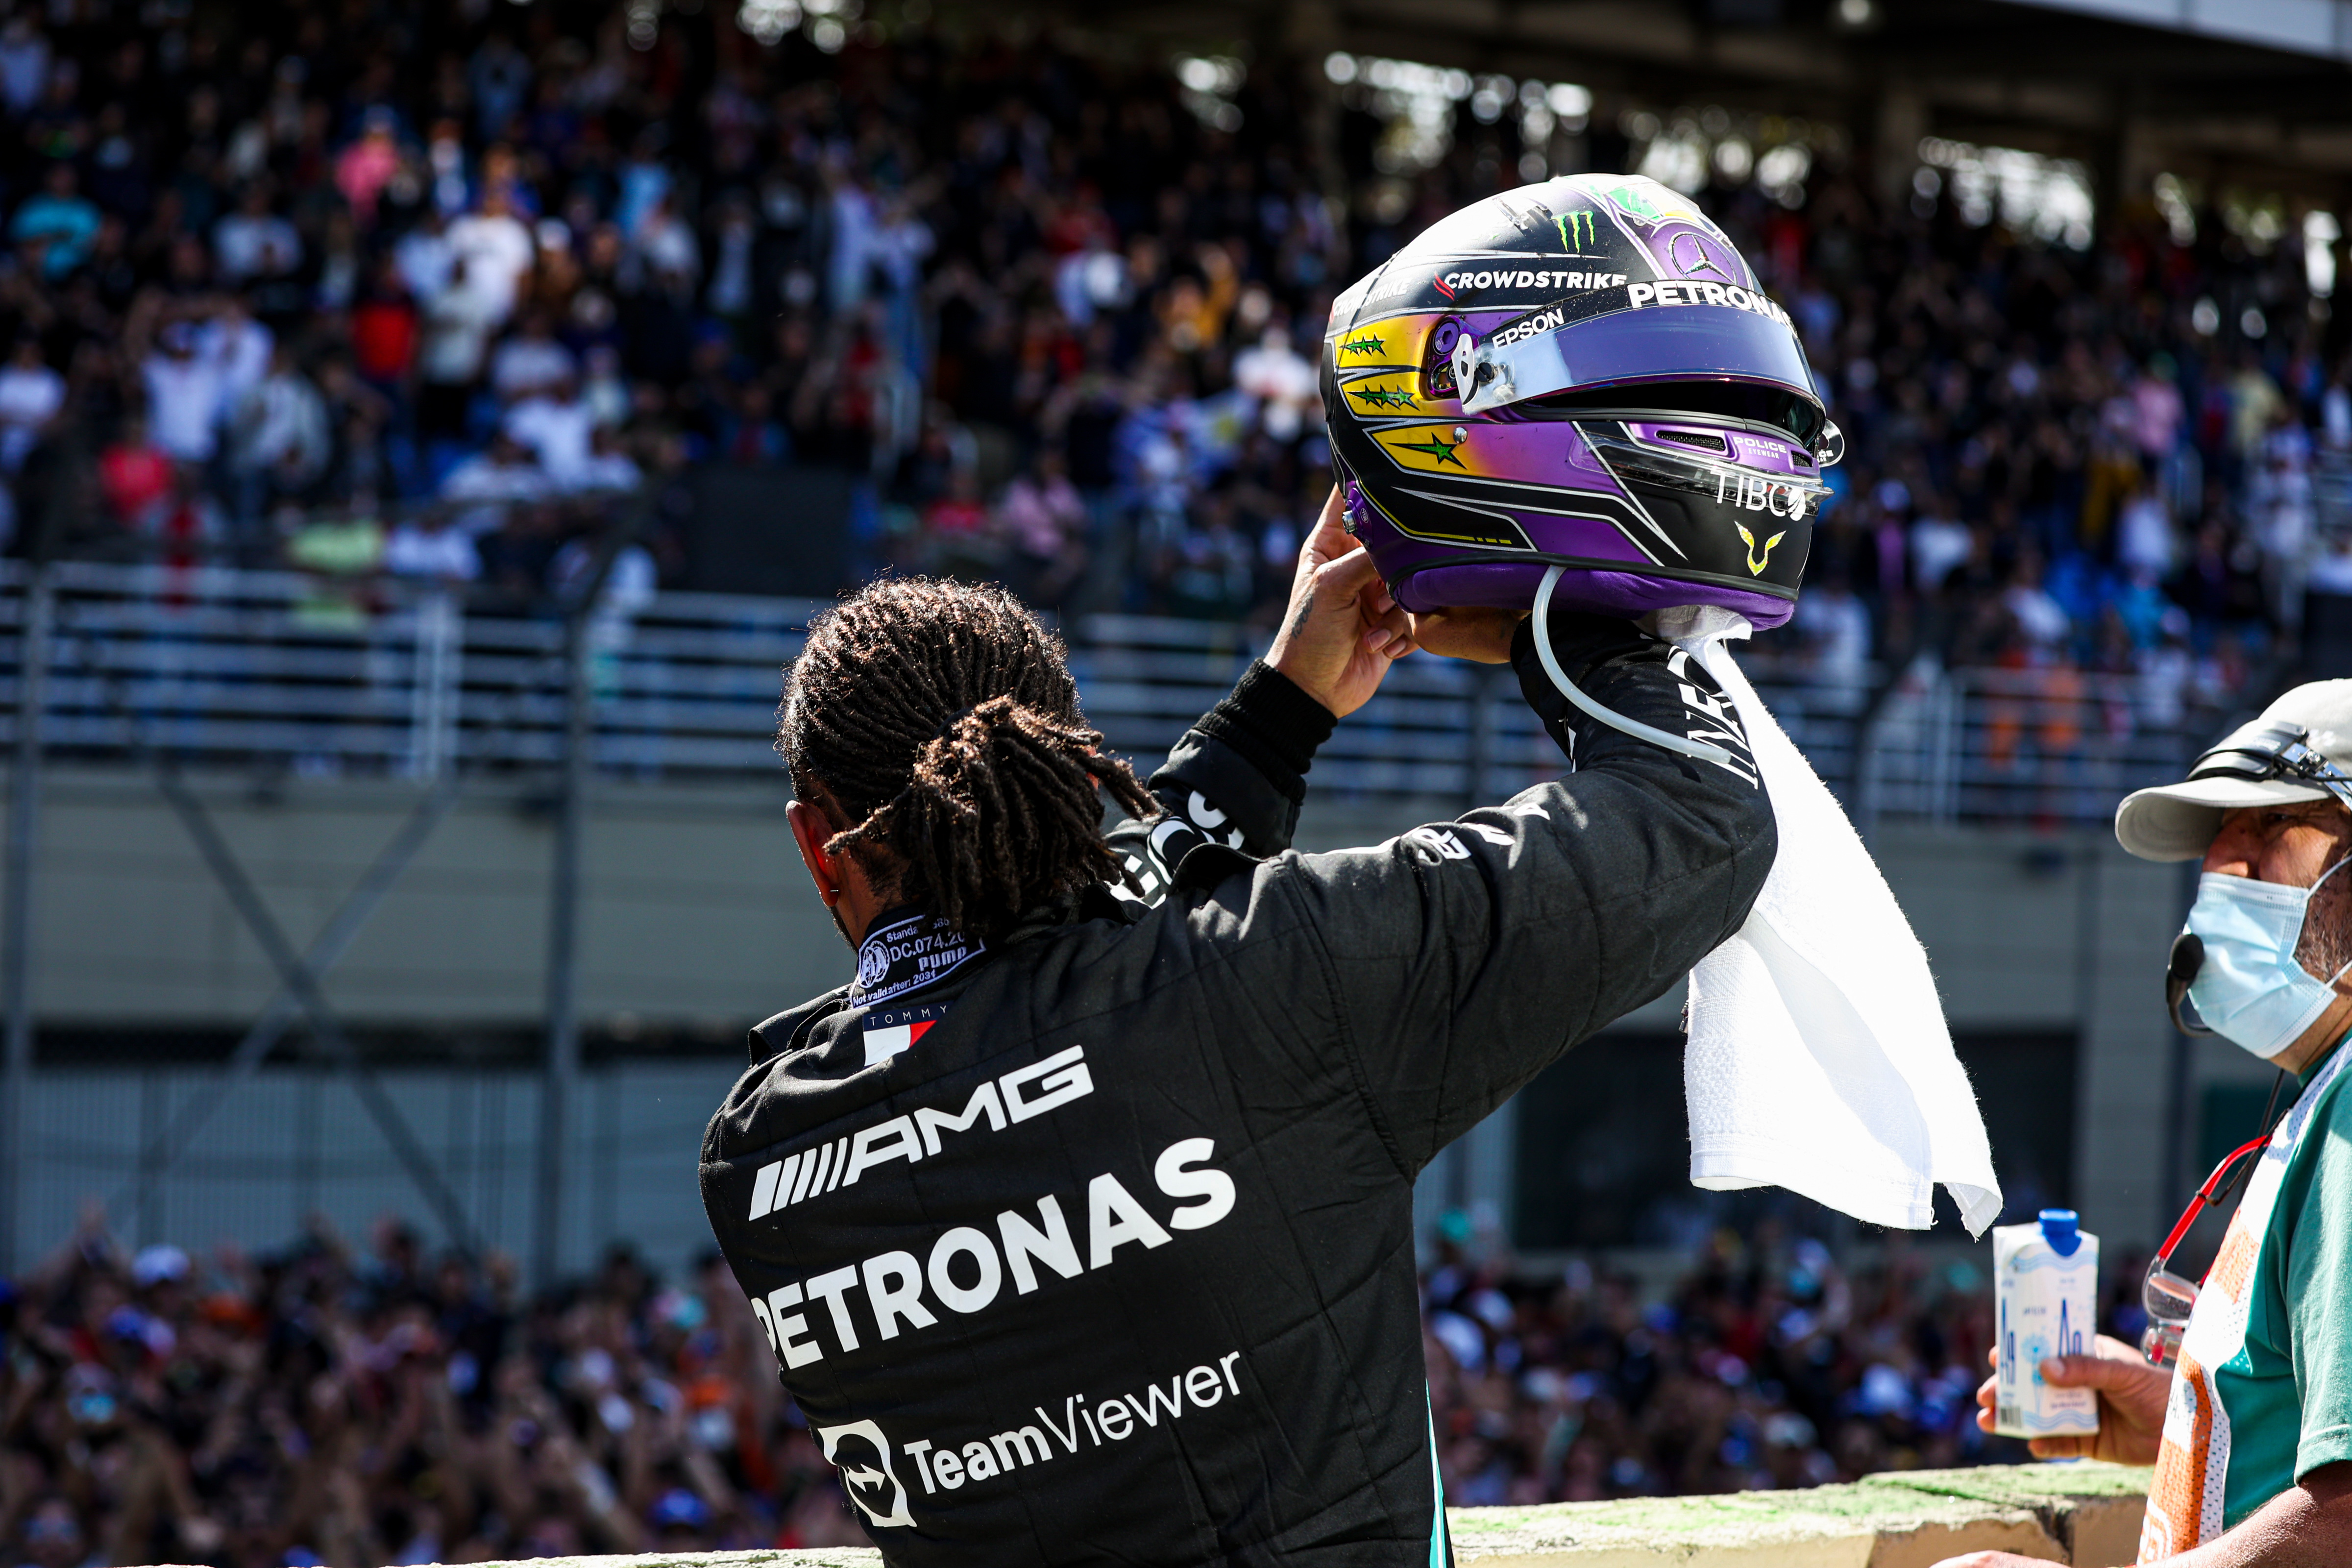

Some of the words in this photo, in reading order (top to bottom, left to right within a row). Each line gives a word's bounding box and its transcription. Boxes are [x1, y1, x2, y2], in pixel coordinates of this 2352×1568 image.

[1444, 270, 1627, 290] CROWDSTRIKE
[1492, 308, 1565, 349] EPSON
[1733, 436, 1787, 454] POLICE
[1748, 447, 1780, 460] EYEWEAR
[886, 925, 918, 943] Standa
[870, 1005, 947, 1026] TOMMY
[843, 1045, 1095, 1187] AMG
[752, 1137, 1236, 1369] PETRONAS
[904, 1351, 1241, 1494] TeamViewer
